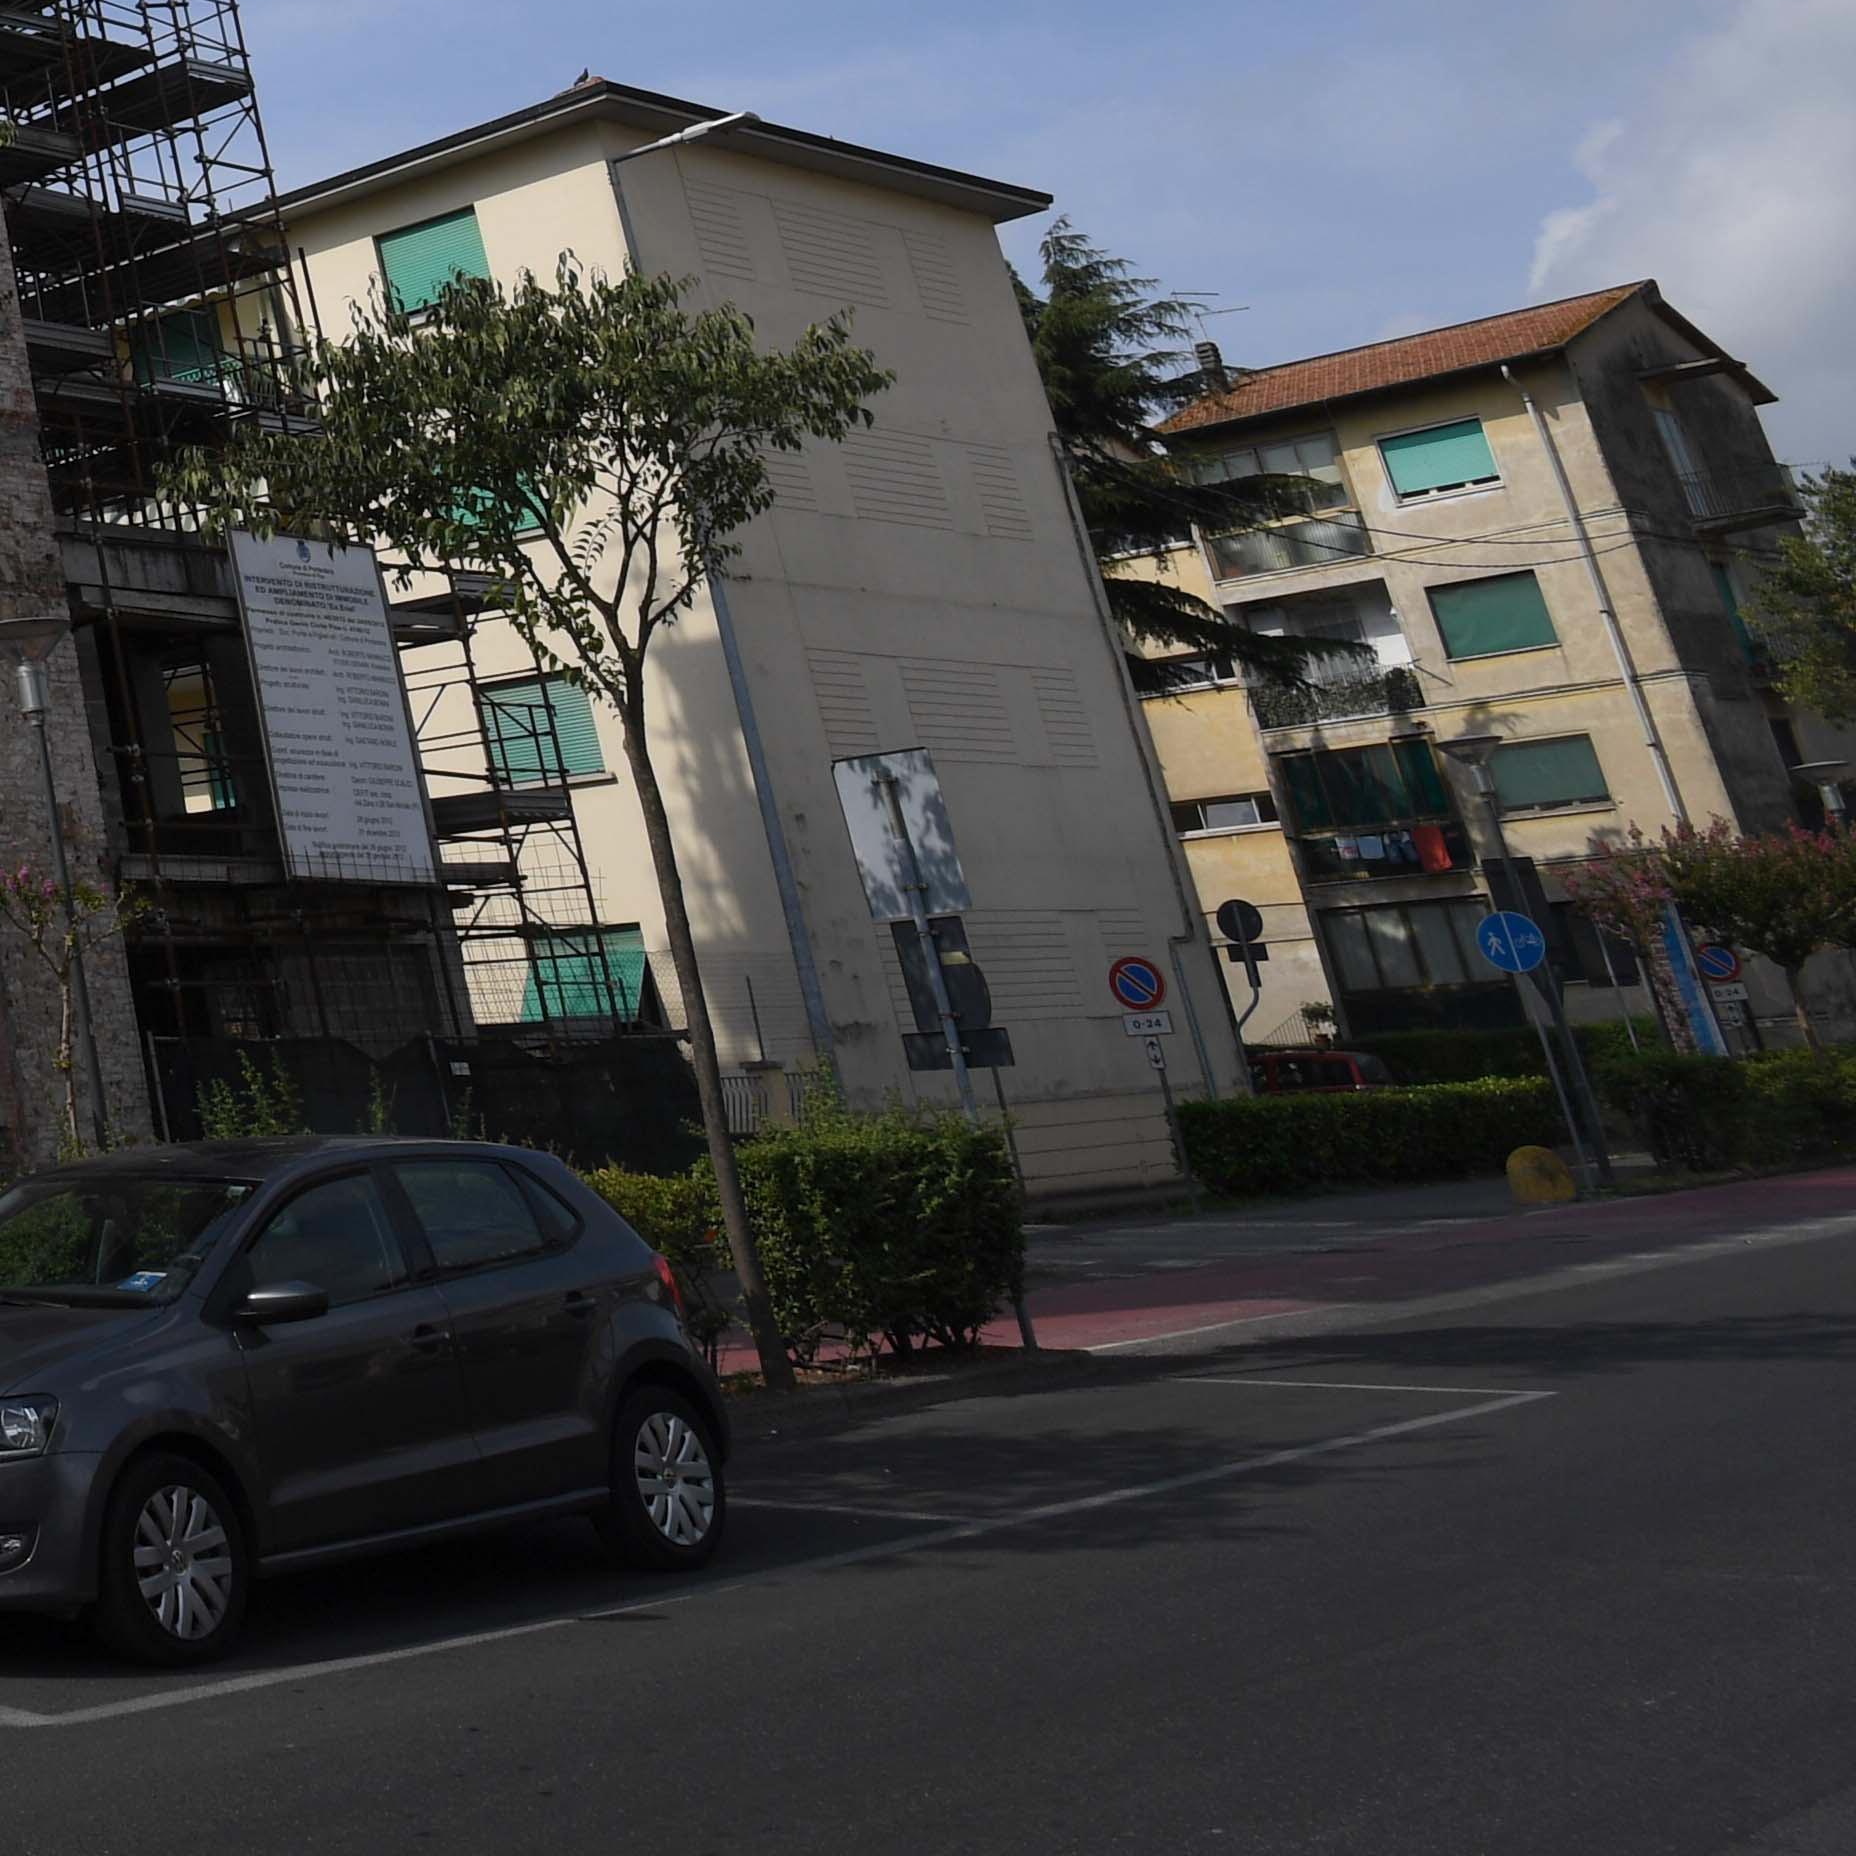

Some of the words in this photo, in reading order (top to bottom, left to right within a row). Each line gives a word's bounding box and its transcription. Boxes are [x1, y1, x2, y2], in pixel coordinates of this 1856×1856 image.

[244, 575, 293, 587] INTERVENTO
[294, 580, 304, 588] DI
[304, 582, 376, 598] RISTRUTTURAZIONE
[255, 585, 266, 593] ED
[267, 586, 325, 600] AMPLIAMENTO
[334, 594, 368, 606] IMMOBILE
[274, 597, 326, 609] DENOMINATO
[1132, 1018, 1162, 1029] 0-24
